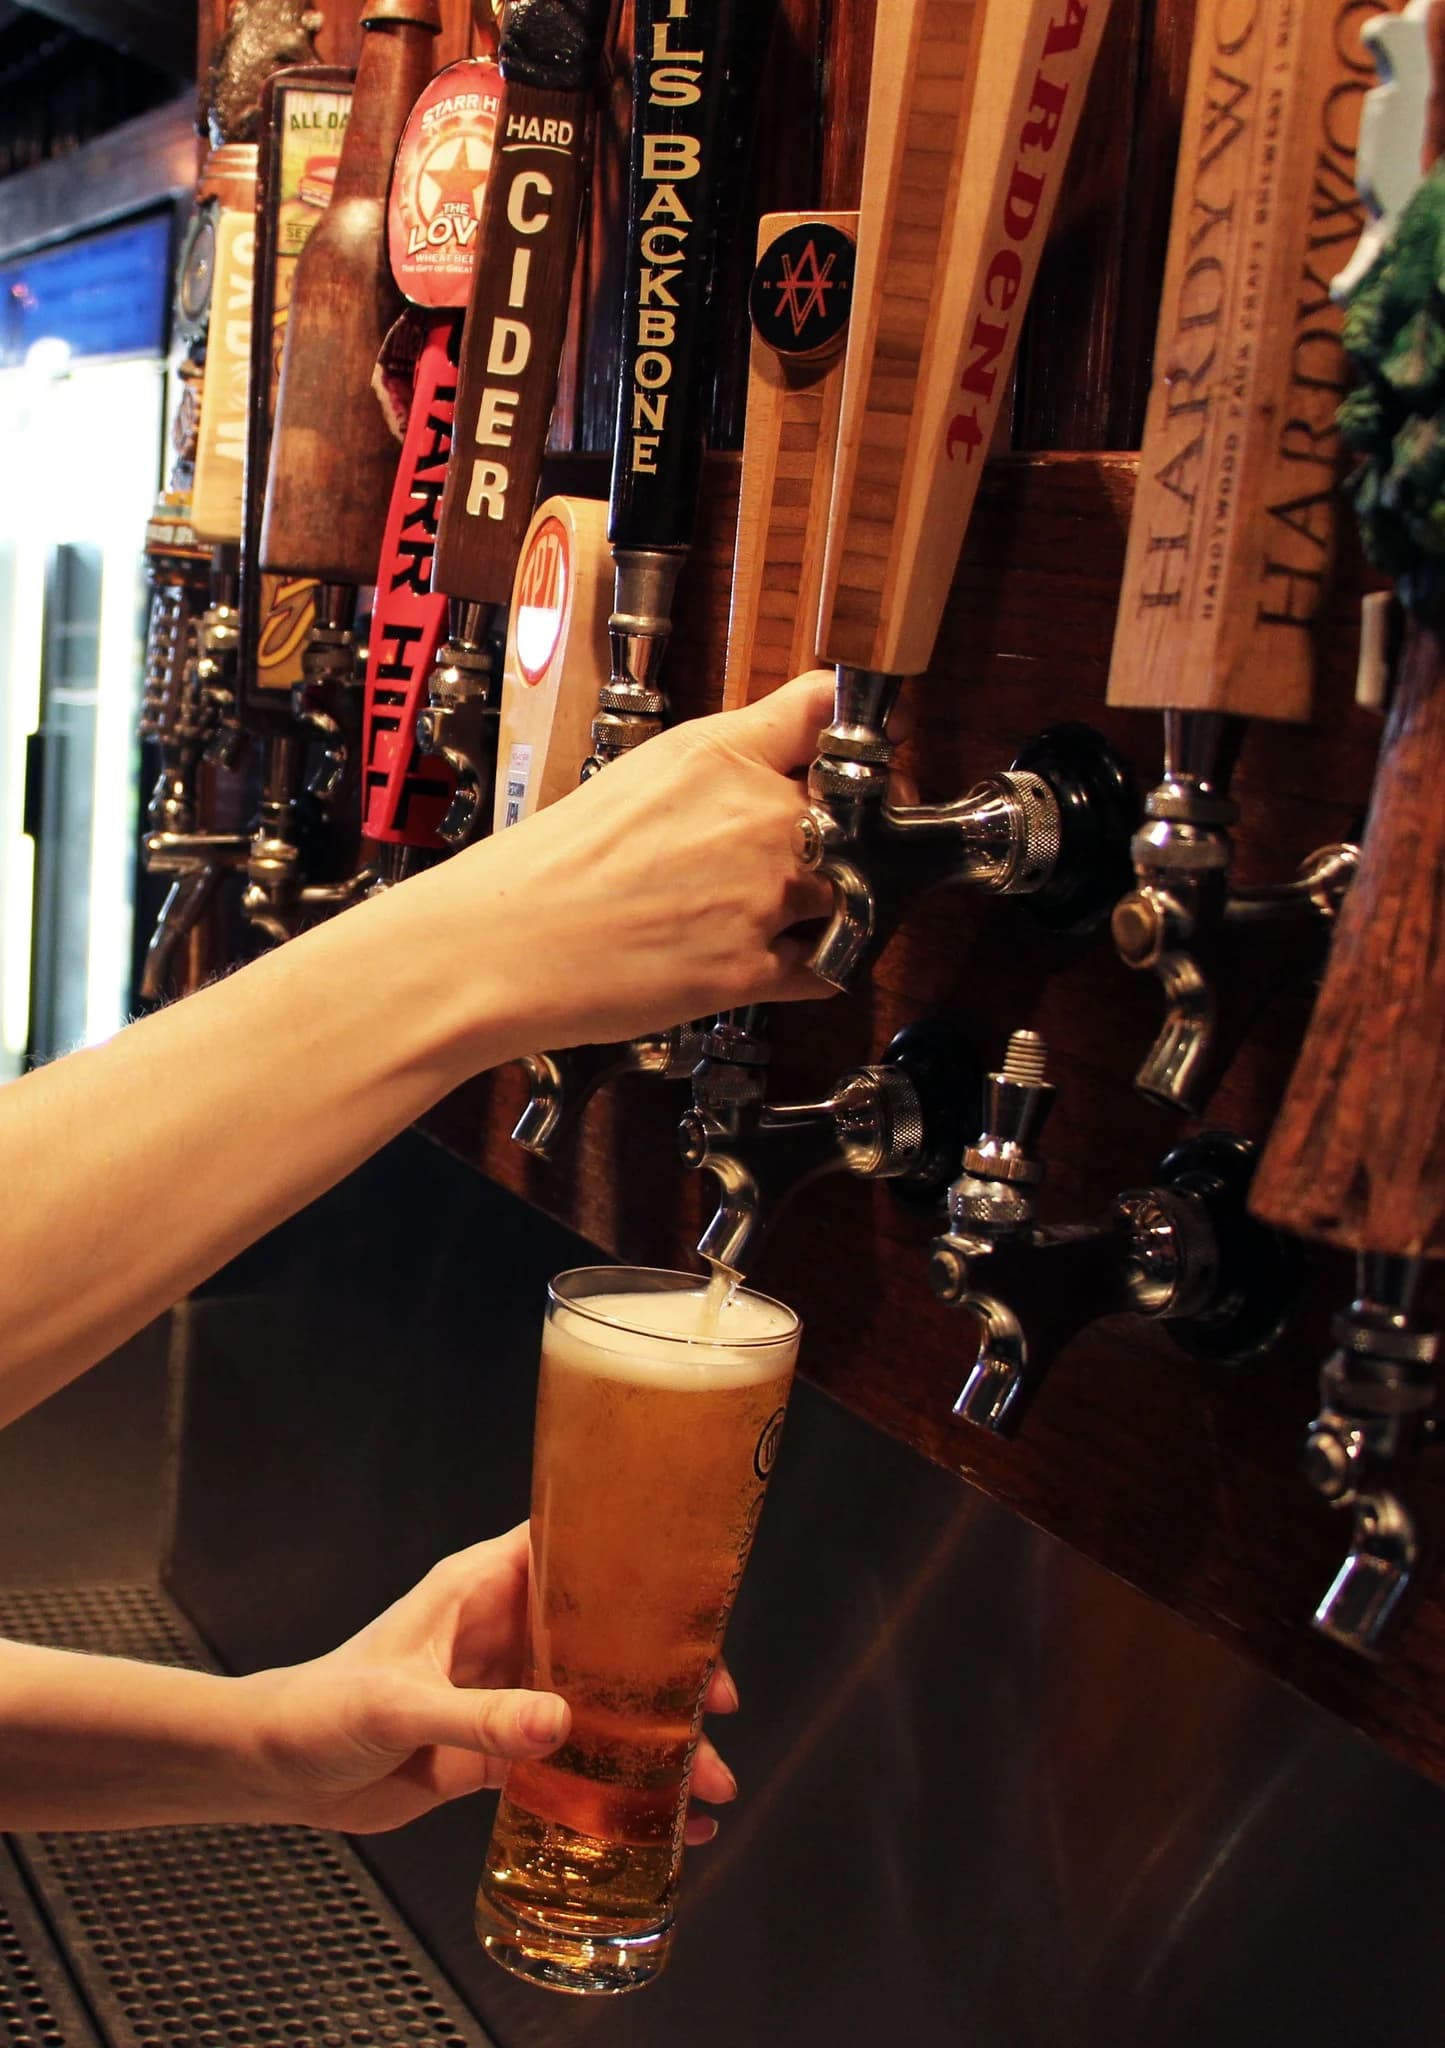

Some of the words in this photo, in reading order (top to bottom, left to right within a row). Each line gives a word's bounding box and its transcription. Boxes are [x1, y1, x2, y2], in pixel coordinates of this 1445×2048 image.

[290, 111, 322, 131] ALL
[327, 111, 351, 130] DA
[421, 93, 480, 130] STARR
[506, 113, 574, 146] HARD
[442, 202, 470, 215] THE
[407, 216, 479, 256] LOV
[415, 252, 452, 263] WHEAT
[631, 134, 701, 474] BACKBONE
[466, 170, 553, 521] CIDER
[364, 623, 425, 824] HILL
